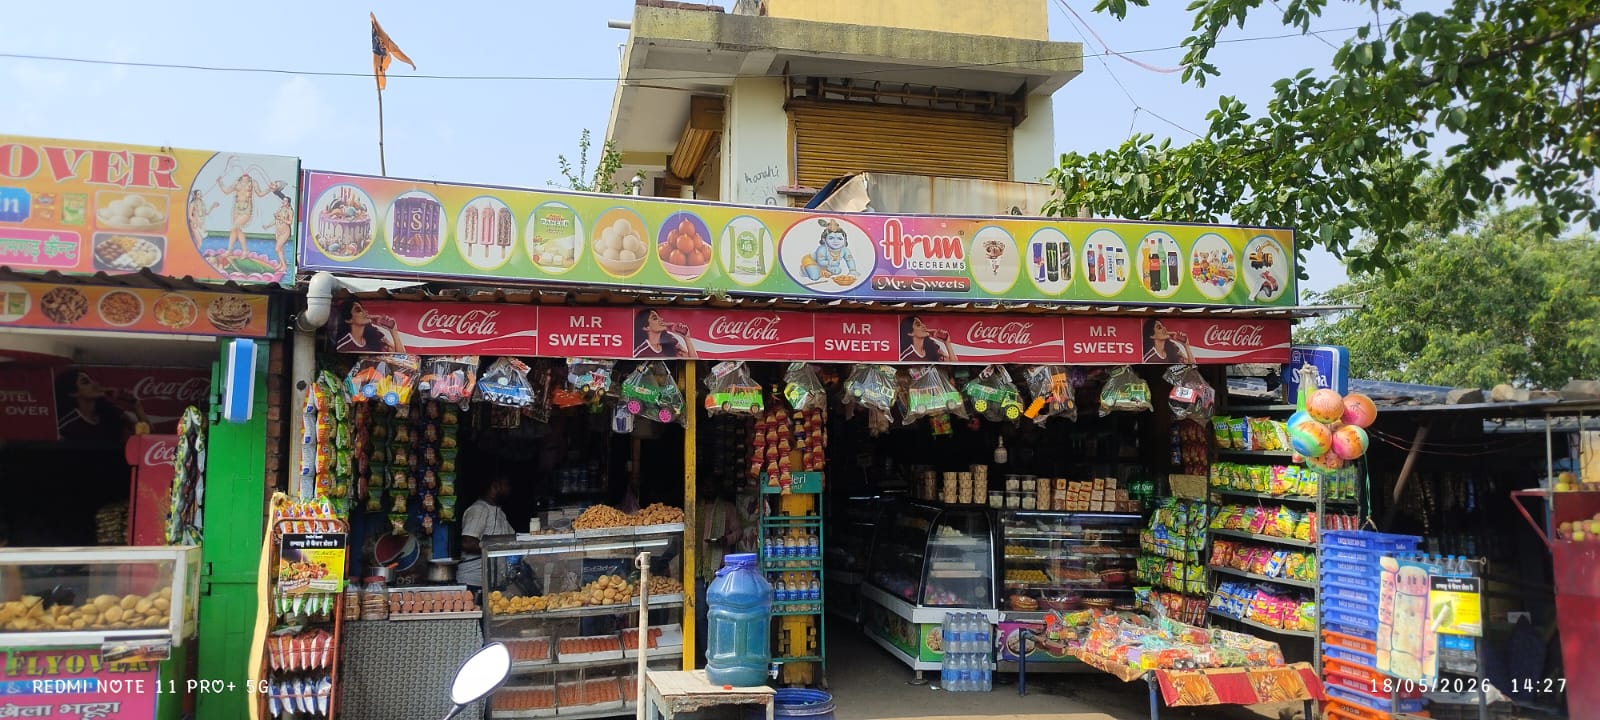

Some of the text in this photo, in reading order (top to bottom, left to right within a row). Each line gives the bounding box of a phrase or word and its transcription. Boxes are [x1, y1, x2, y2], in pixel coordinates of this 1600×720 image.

[880, 218, 964, 267] Arun
[907, 260, 965, 270] ICECREAMS
[877, 276, 965, 291] Mr. Sweets
[417, 308, 500, 336] Coca-Cola
[569, 315, 602, 329] M.R
[708, 315, 781, 341] Coca-Cola
[842, 322, 872, 335] M.R
[966, 321, 1034, 345] Coca-Cola
[1089, 326, 1117, 337] M.R
[1203, 324, 1264, 346] Coca-Cola
[548, 333, 623, 347] SWEETS
[824, 339, 891, 352] SWEETS
[1072, 342, 1134, 354] SWEETS
[5, 406, 49, 416] OVER
